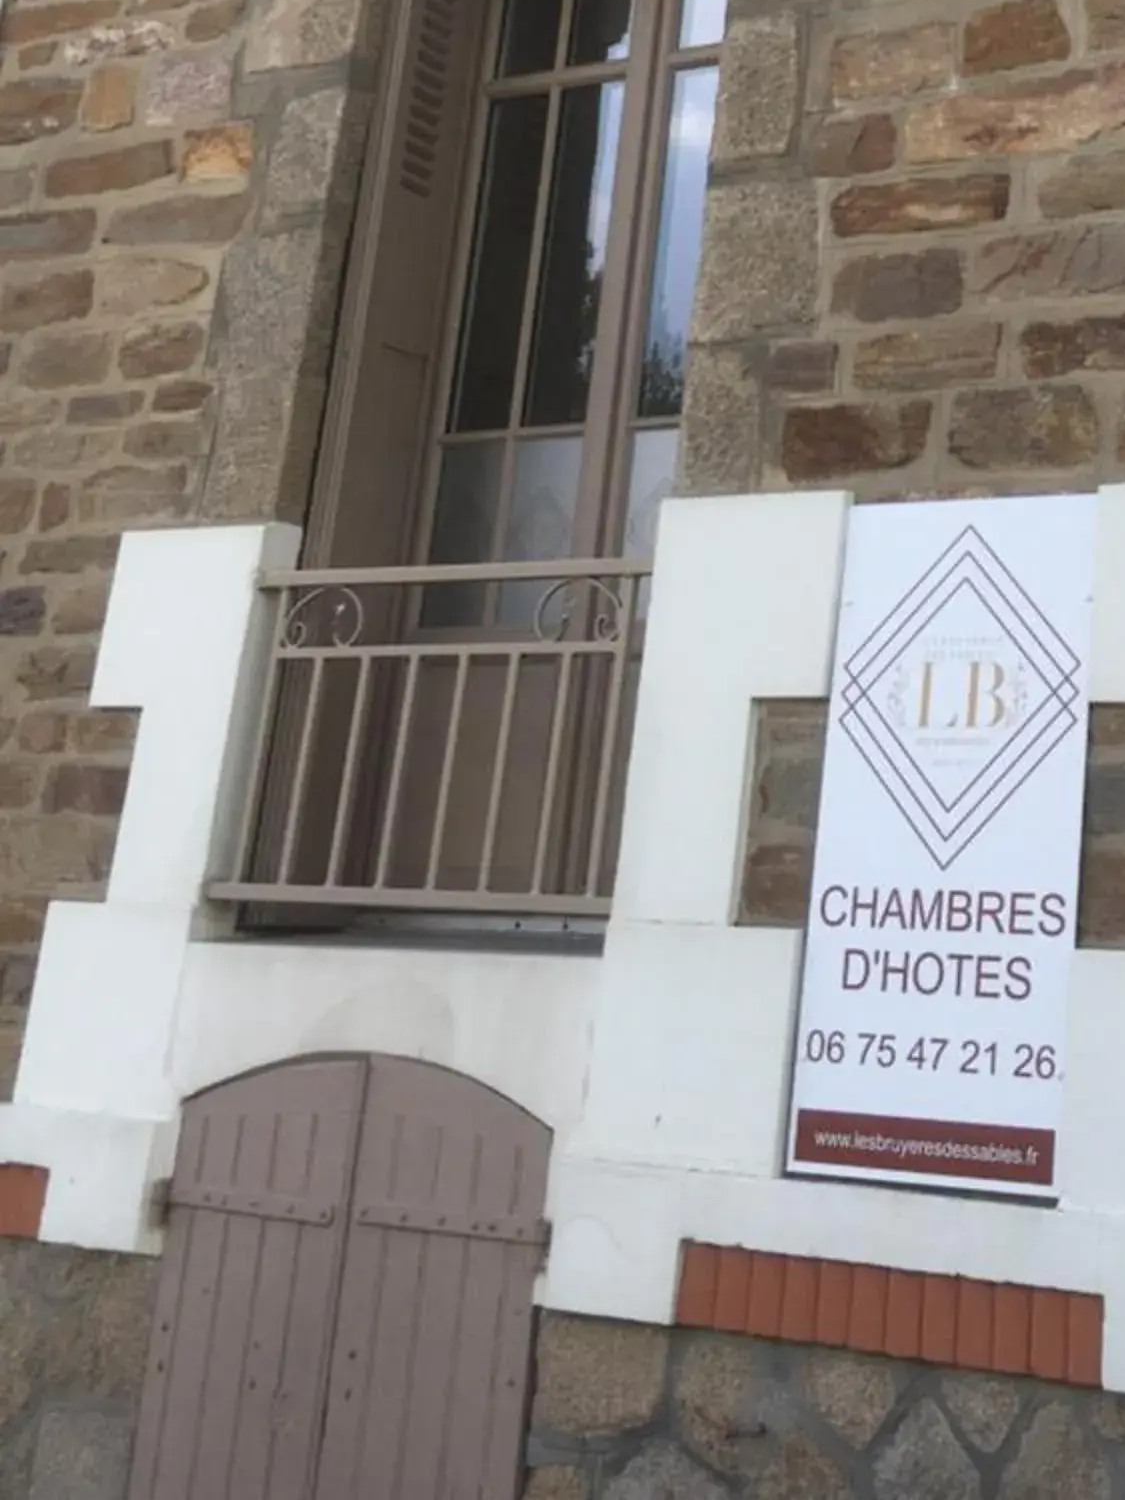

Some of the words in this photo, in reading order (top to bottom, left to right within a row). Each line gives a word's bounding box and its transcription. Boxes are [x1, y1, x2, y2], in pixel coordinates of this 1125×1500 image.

[820, 885, 1067, 937] CHAMBRES
[841, 948, 1033, 1001] D'HOTES
[805, 1029, 845, 1064] 06
[857, 1033, 897, 1068] 75
[906, 1037, 949, 1071] 47
[959, 1040, 998, 1076] 21
[1012, 1044, 1057, 1080] 26
[813, 1129, 1041, 1166] www.lesbruyeresdessables.fr
